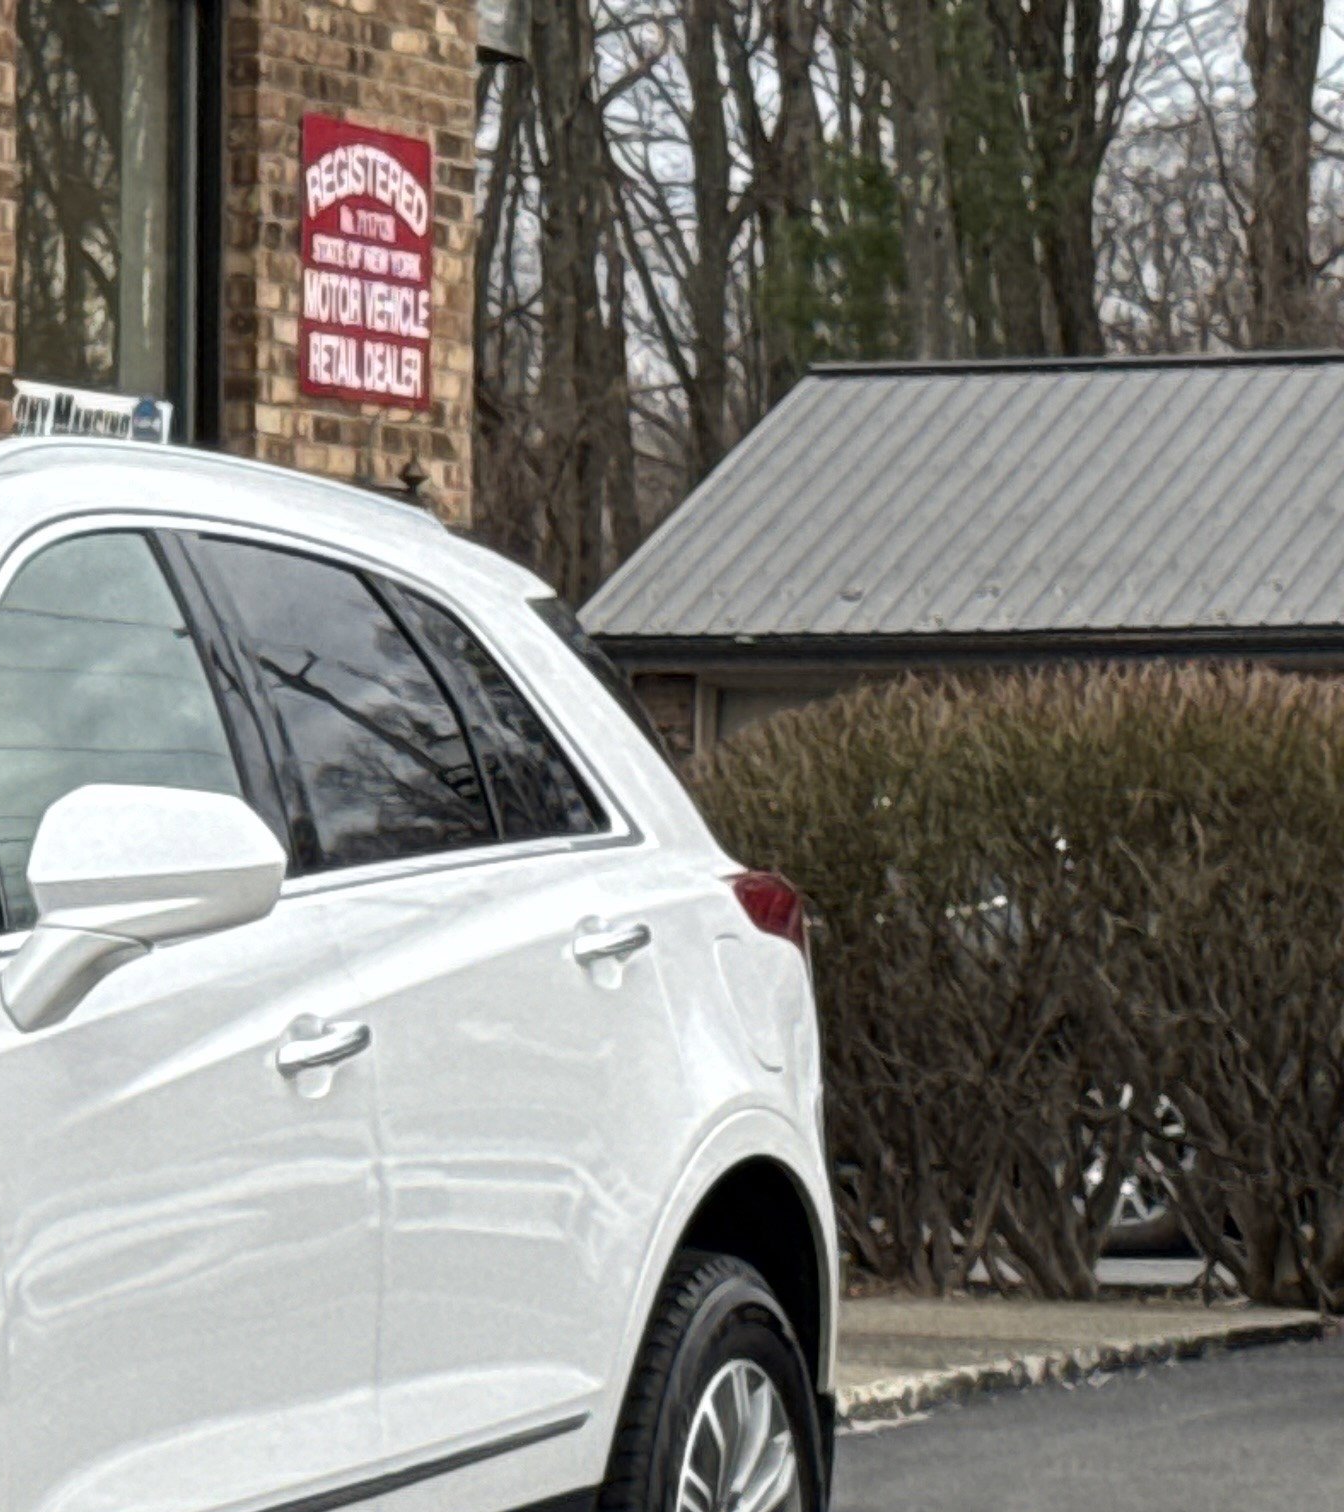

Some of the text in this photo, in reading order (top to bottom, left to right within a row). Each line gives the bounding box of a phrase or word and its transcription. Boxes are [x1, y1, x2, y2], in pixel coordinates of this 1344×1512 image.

[305, 144, 428, 237] REGISTERED
[304, 267, 430, 339] MOTOR VEHICLE
[308, 332, 422, 399] RETAIL DEALER
[14, 393, 51, 437] ONY
